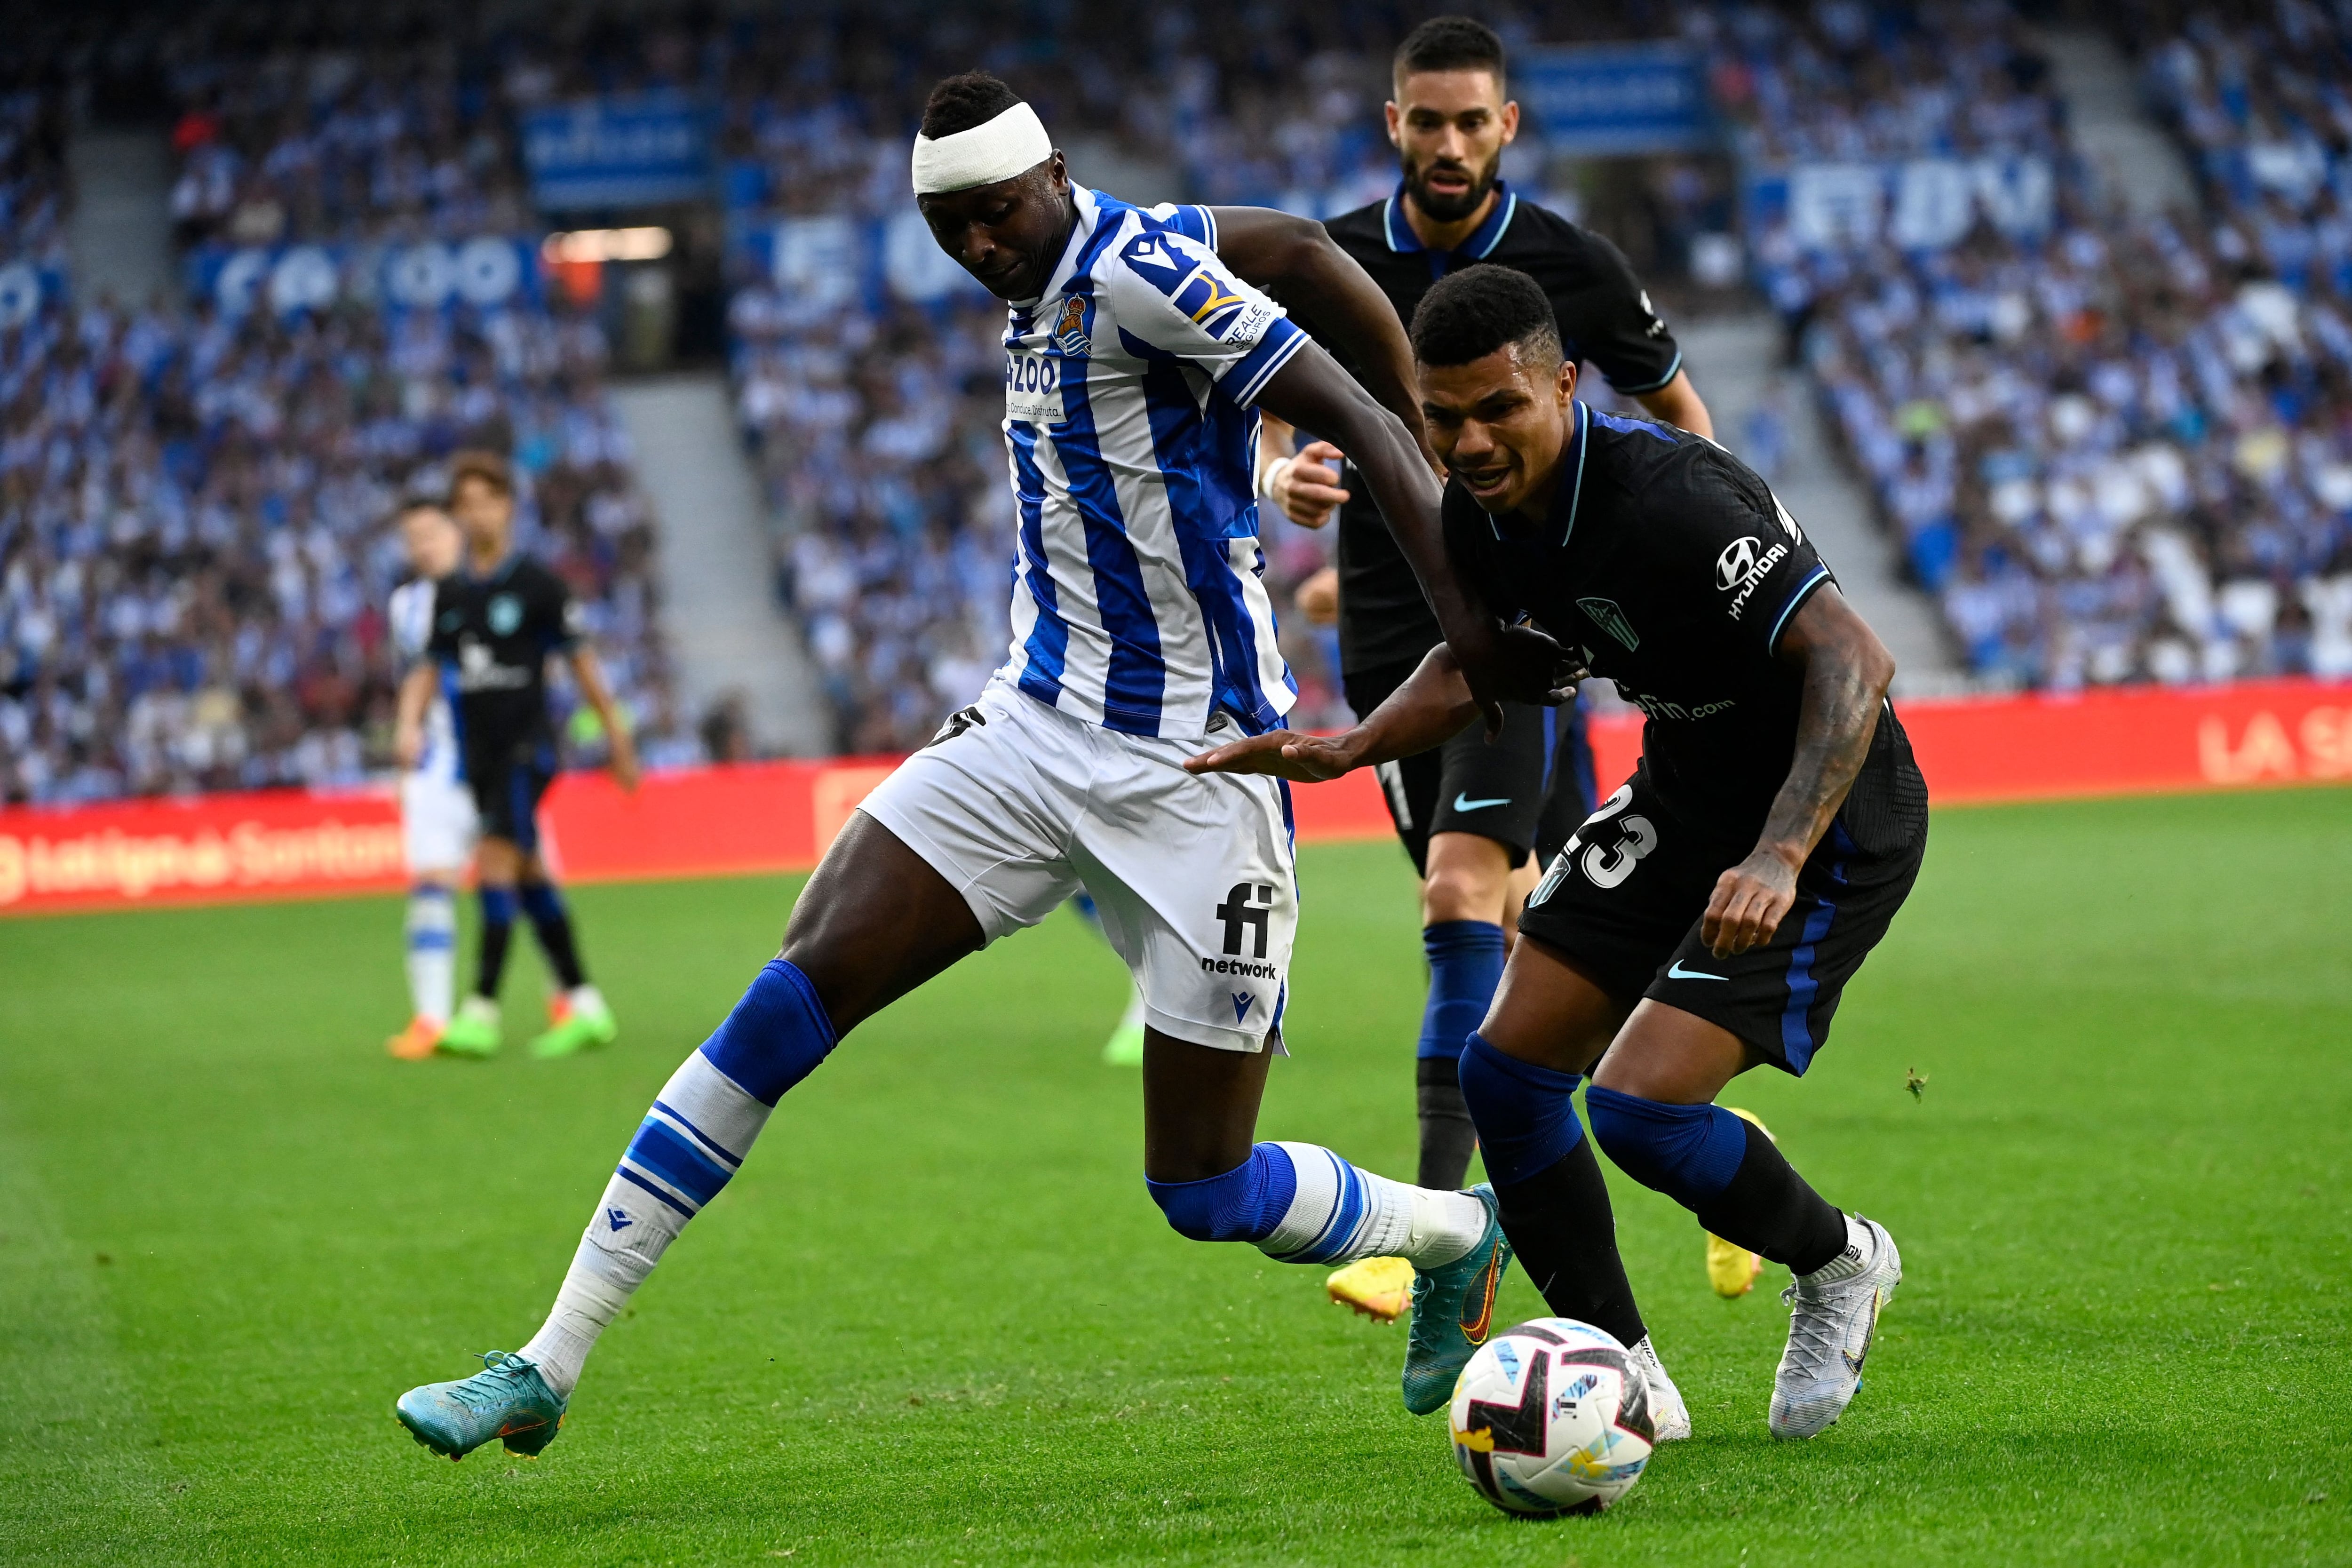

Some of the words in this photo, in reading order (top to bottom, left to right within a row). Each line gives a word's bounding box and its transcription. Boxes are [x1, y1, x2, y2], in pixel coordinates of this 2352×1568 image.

[1225, 304, 1262, 346] REALE
[1236, 311, 1271, 350] SEGUROS
[1032, 405, 1062, 417] Disfruta.
[1728, 543, 1788, 621] HYUNDAI
[1563, 784, 1657, 889] 23
[1216, 882, 1272, 960] fi
[1201, 957, 1276, 980] network
